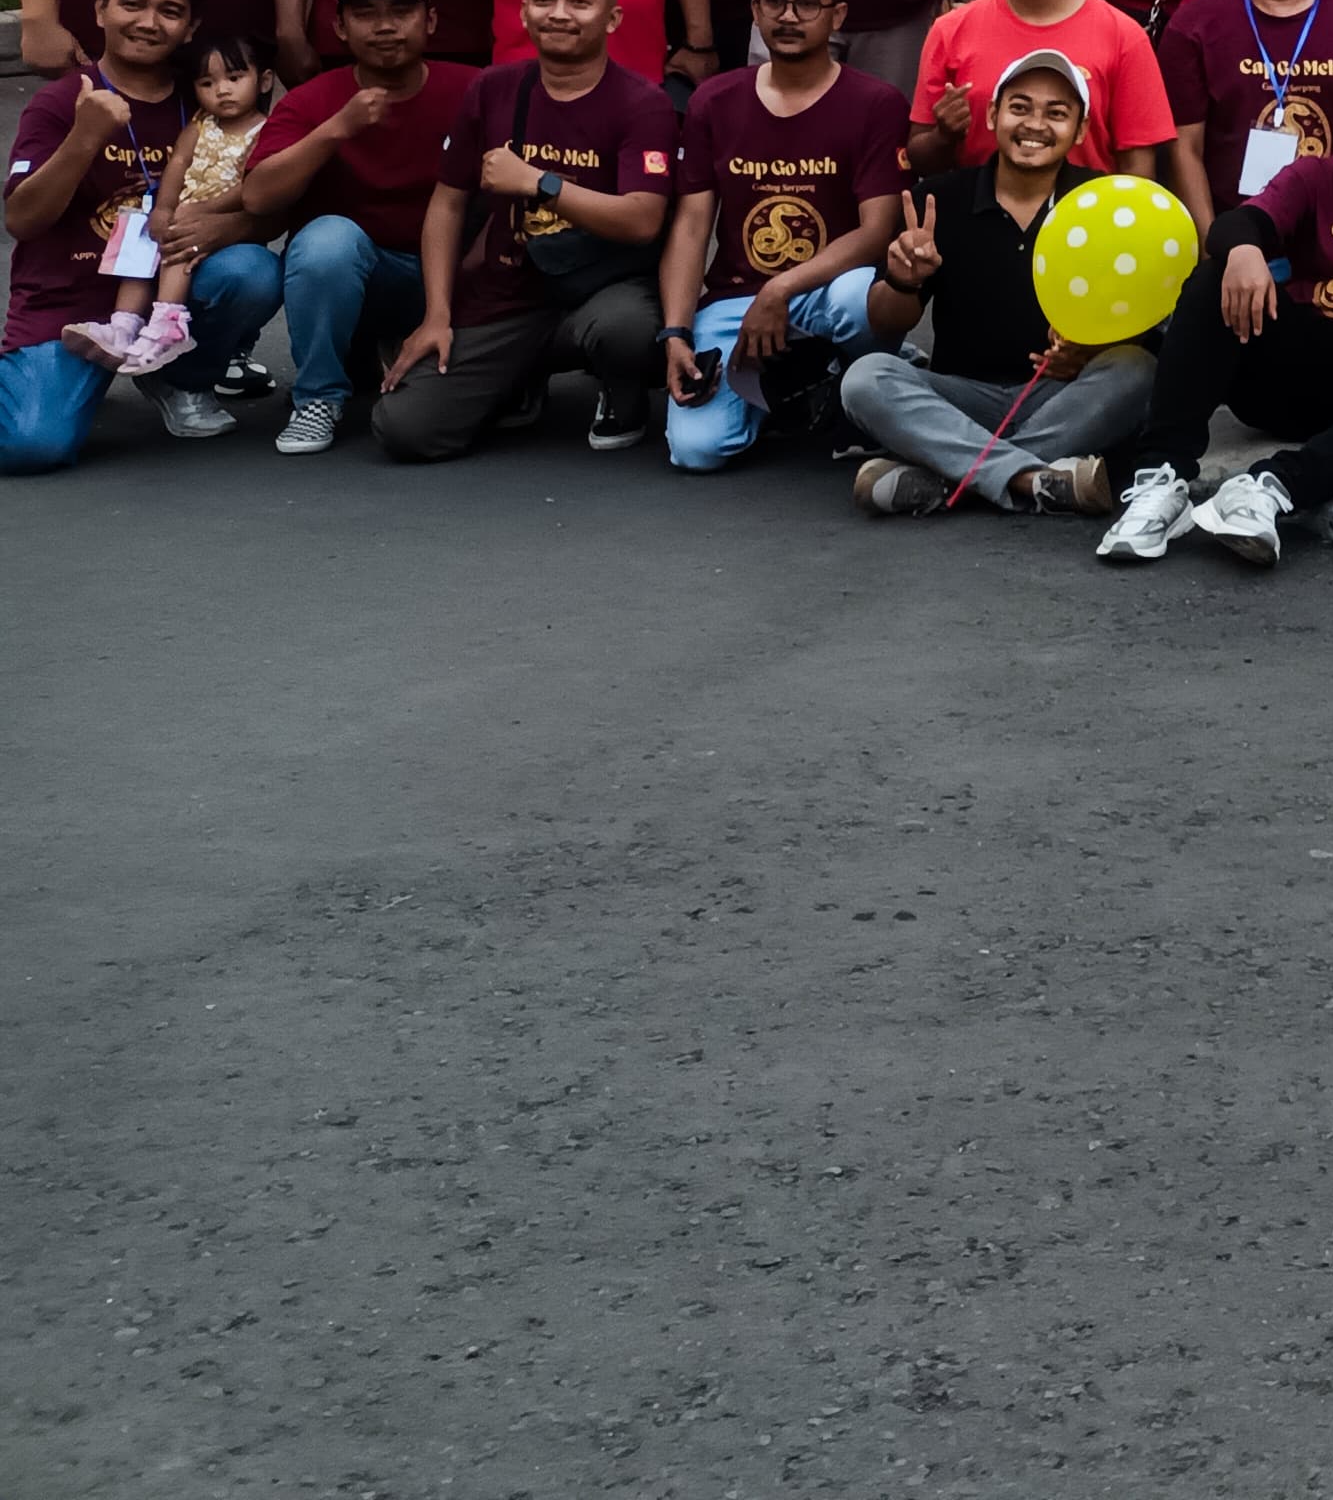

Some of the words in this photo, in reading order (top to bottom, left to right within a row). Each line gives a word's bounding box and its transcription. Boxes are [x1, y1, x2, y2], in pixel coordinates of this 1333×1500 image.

[105, 144, 136, 167] Cap
[541, 142, 561, 162] Go
[563, 147, 600, 168] Meh
[729, 157, 768, 181] Cap
[771, 158, 796, 177] Go
[801, 157, 837, 177] Meh
